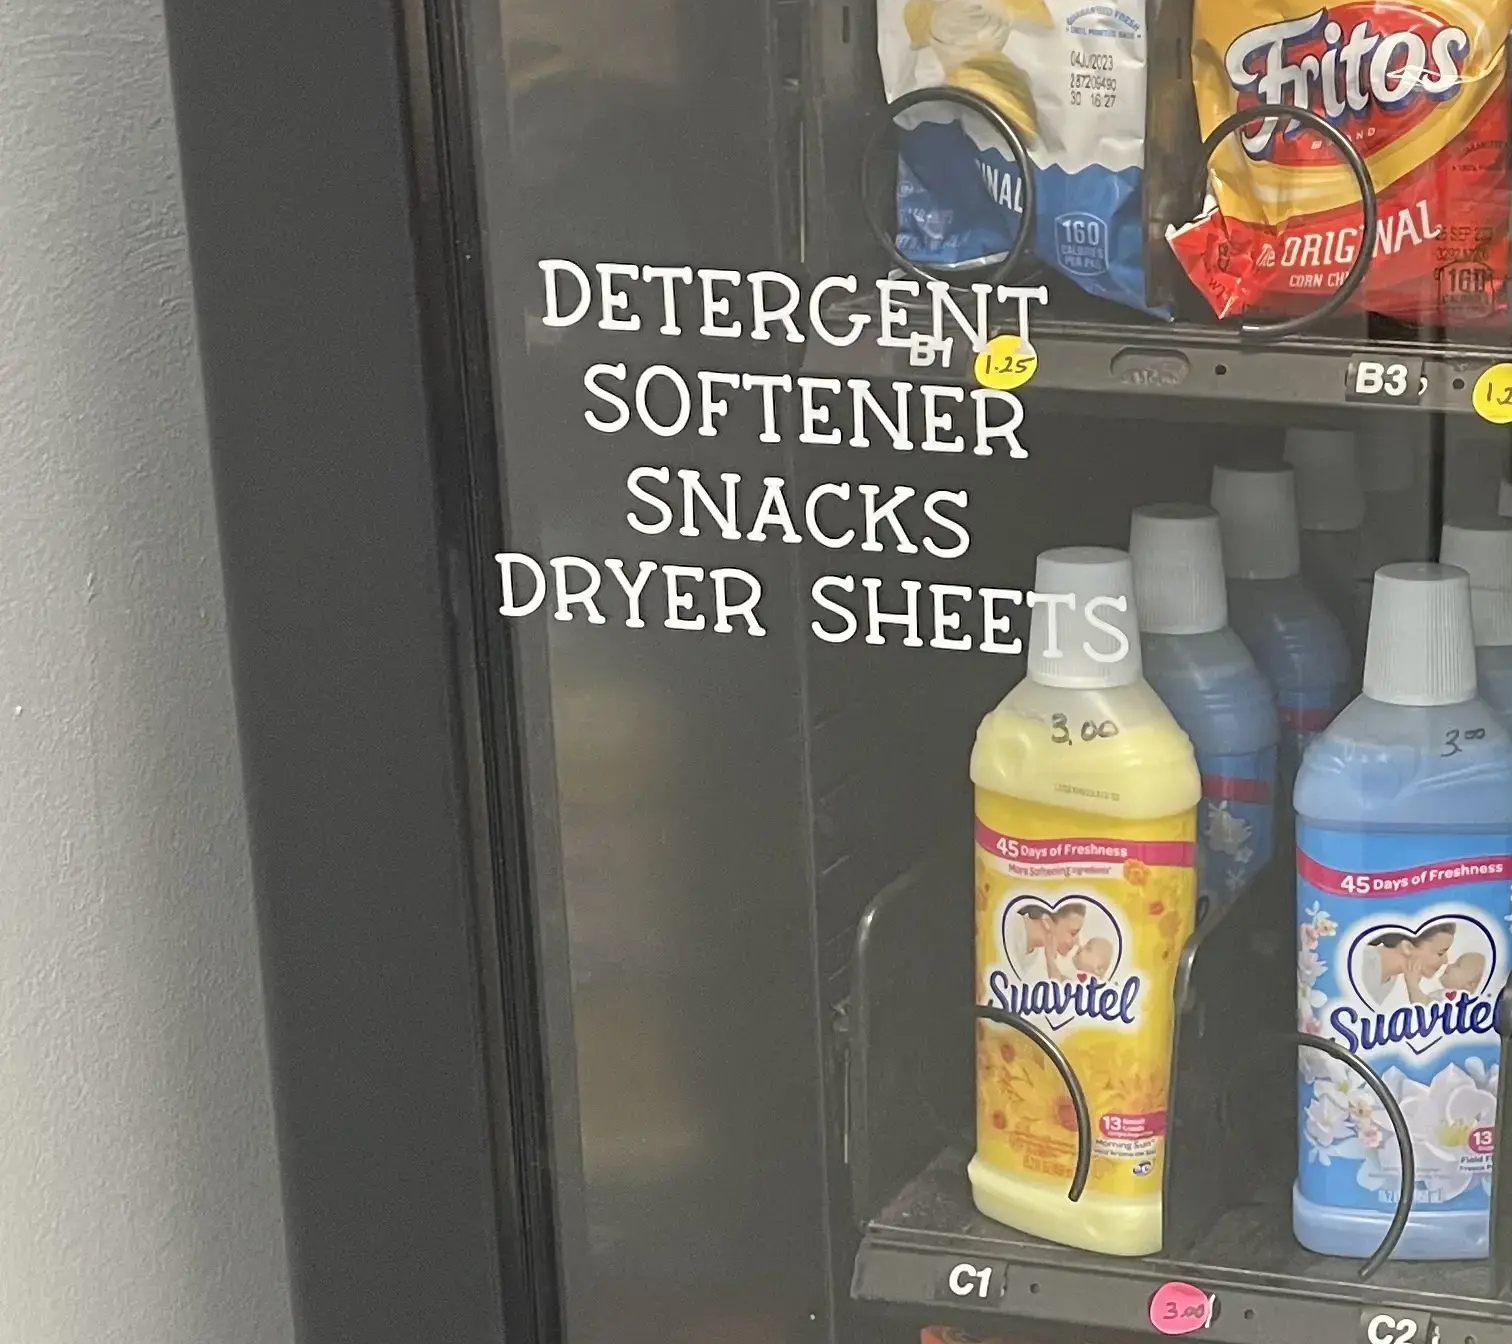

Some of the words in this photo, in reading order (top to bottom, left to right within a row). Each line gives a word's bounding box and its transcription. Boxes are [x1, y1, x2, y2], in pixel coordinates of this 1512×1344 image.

[1226, 7, 1468, 153] Fritos
[1061, 218, 1100, 246] 160
[1281, 198, 1444, 269] ORIGNAL
[1289, 272, 1324, 288] CORN
[538, 258, 1050, 355] DETERGENT
[909, 332, 953, 369] B1
[982, 352, 1031, 378] 1.25
[1355, 361, 1409, 396] B3
[583, 362, 1030, 459] SOFTENER
[626, 465, 972, 559] SNACKS
[496, 552, 767, 638] DRYER
[810, 574, 1131, 664] SHEETS
[996, 837, 1020, 858] 45
[1021, 844, 1048, 860] Days
[1050, 843, 1063, 857] of
[1064, 843, 1129, 859] Freshness
[1340, 874, 1371, 895] 45
[1373, 874, 1409, 893] Days
[1411, 870, 1427, 885] of
[1429, 860, 1504, 883] Freshness
[988, 969, 1142, 1026] Suavitel
[1102, 1115, 1122, 1131] 13
[1472, 1130, 1493, 1146] 13
[948, 1263, 993, 1299] C1
